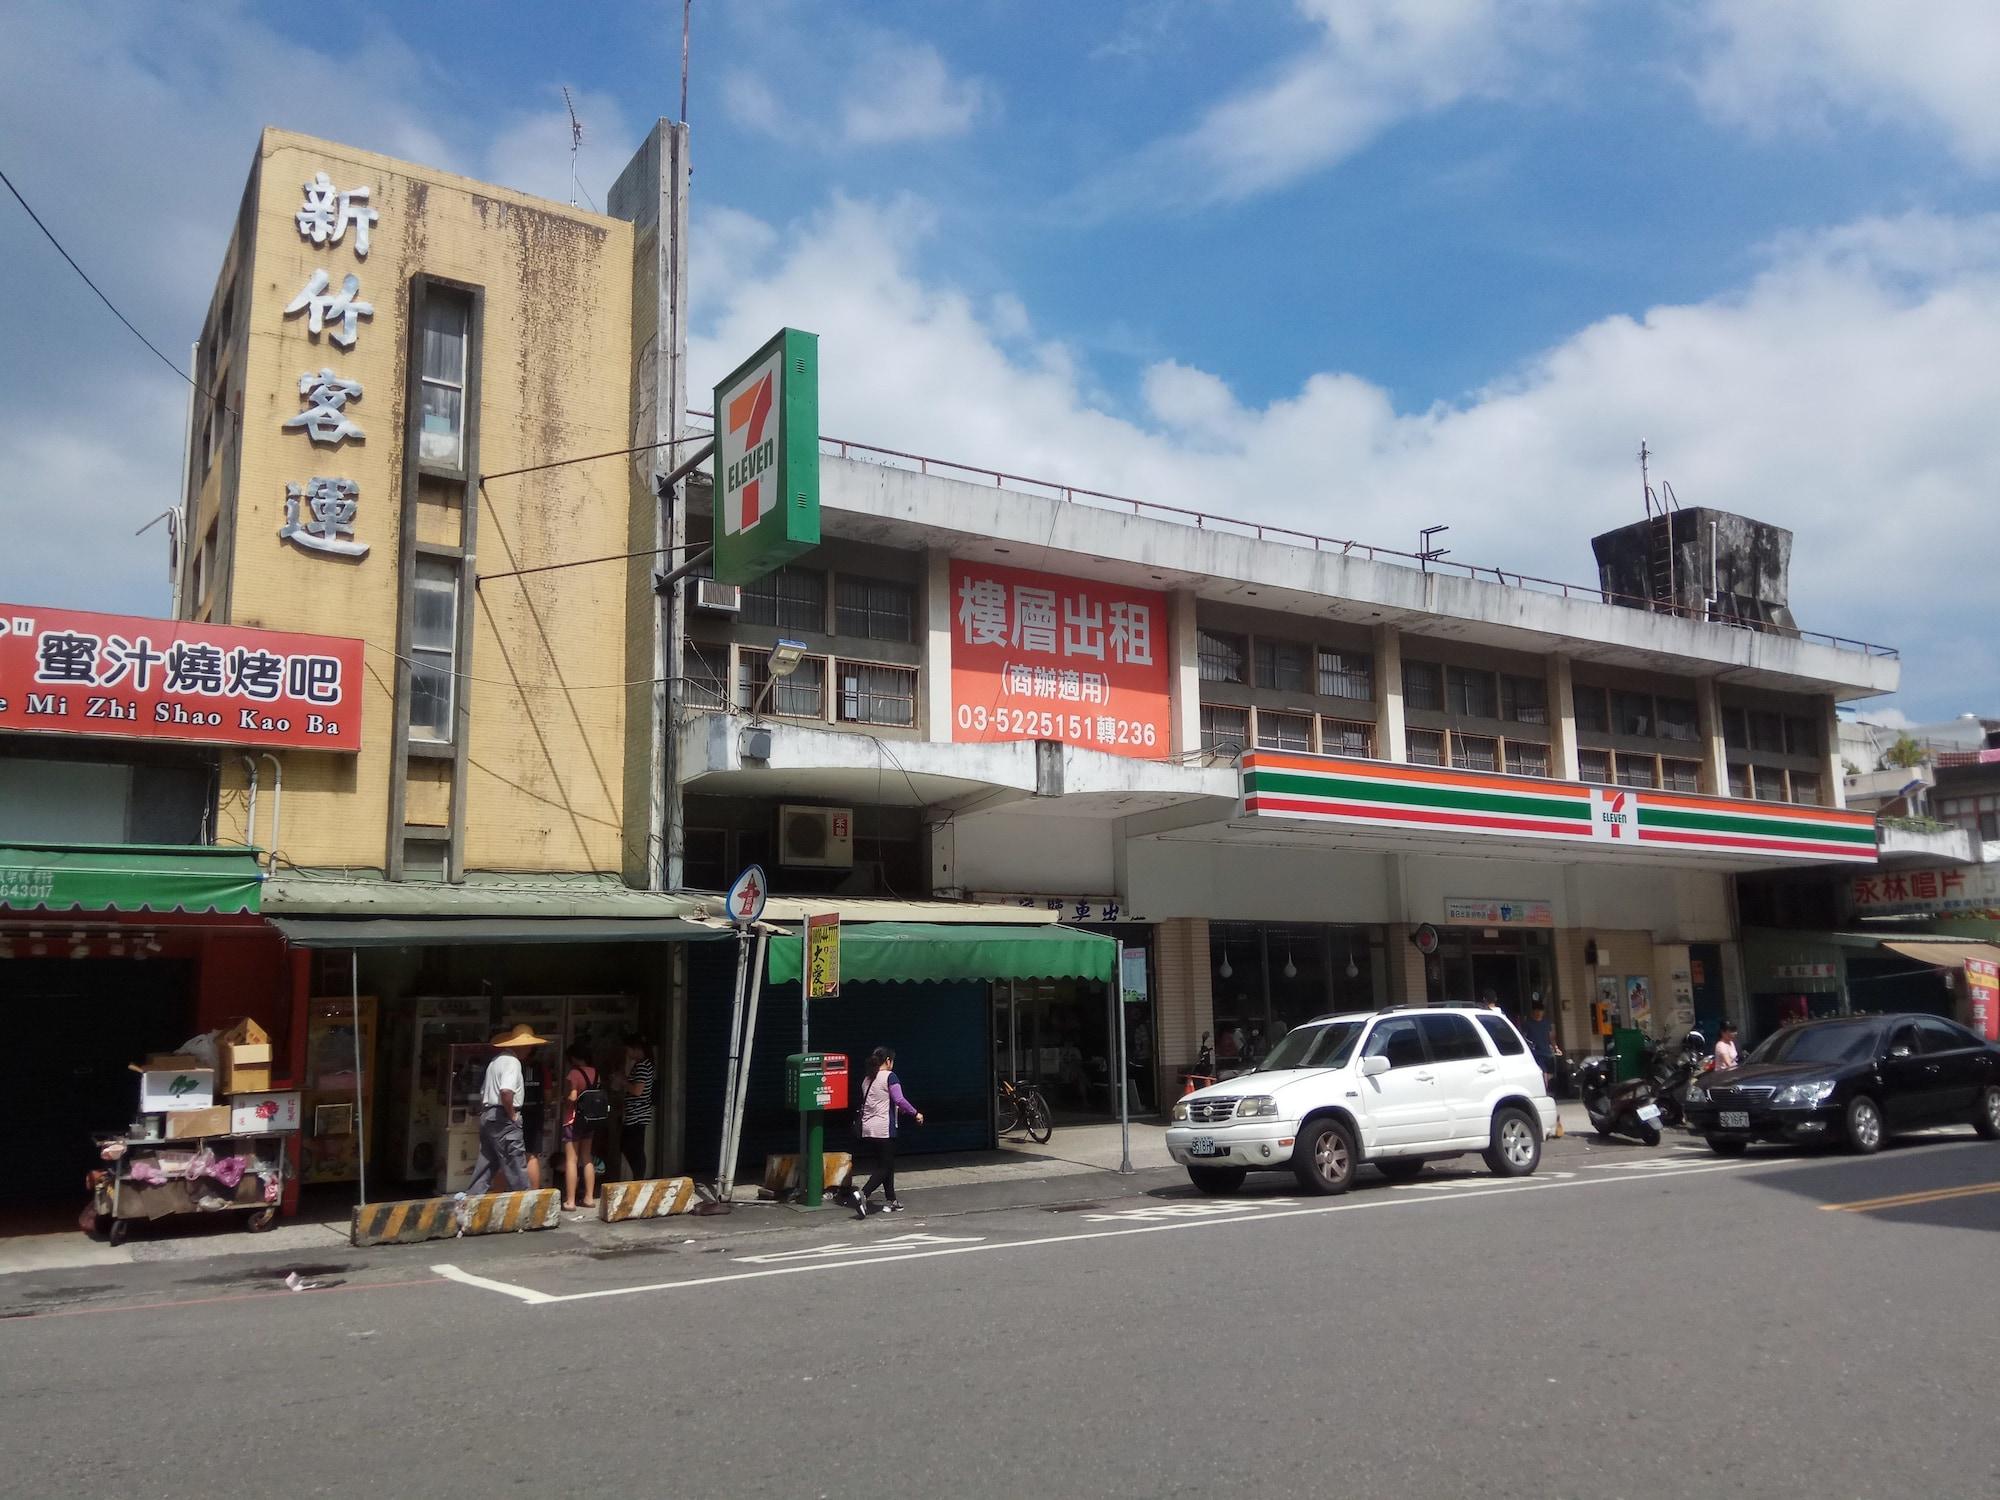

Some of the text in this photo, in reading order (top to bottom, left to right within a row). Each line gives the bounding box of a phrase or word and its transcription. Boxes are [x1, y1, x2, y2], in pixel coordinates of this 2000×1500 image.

[279, 171, 379, 556] 新竹客運
[957, 575, 1153, 666] 樓層出租
[25, 694, 68, 715] Mi
[86, 697, 137, 720] Zhi
[155, 702, 222, 726] Shao
[239, 709, 291, 731] Kao
[306, 714, 340, 735] Ba
[957, 704, 1156, 746] 03-5225151轉236
